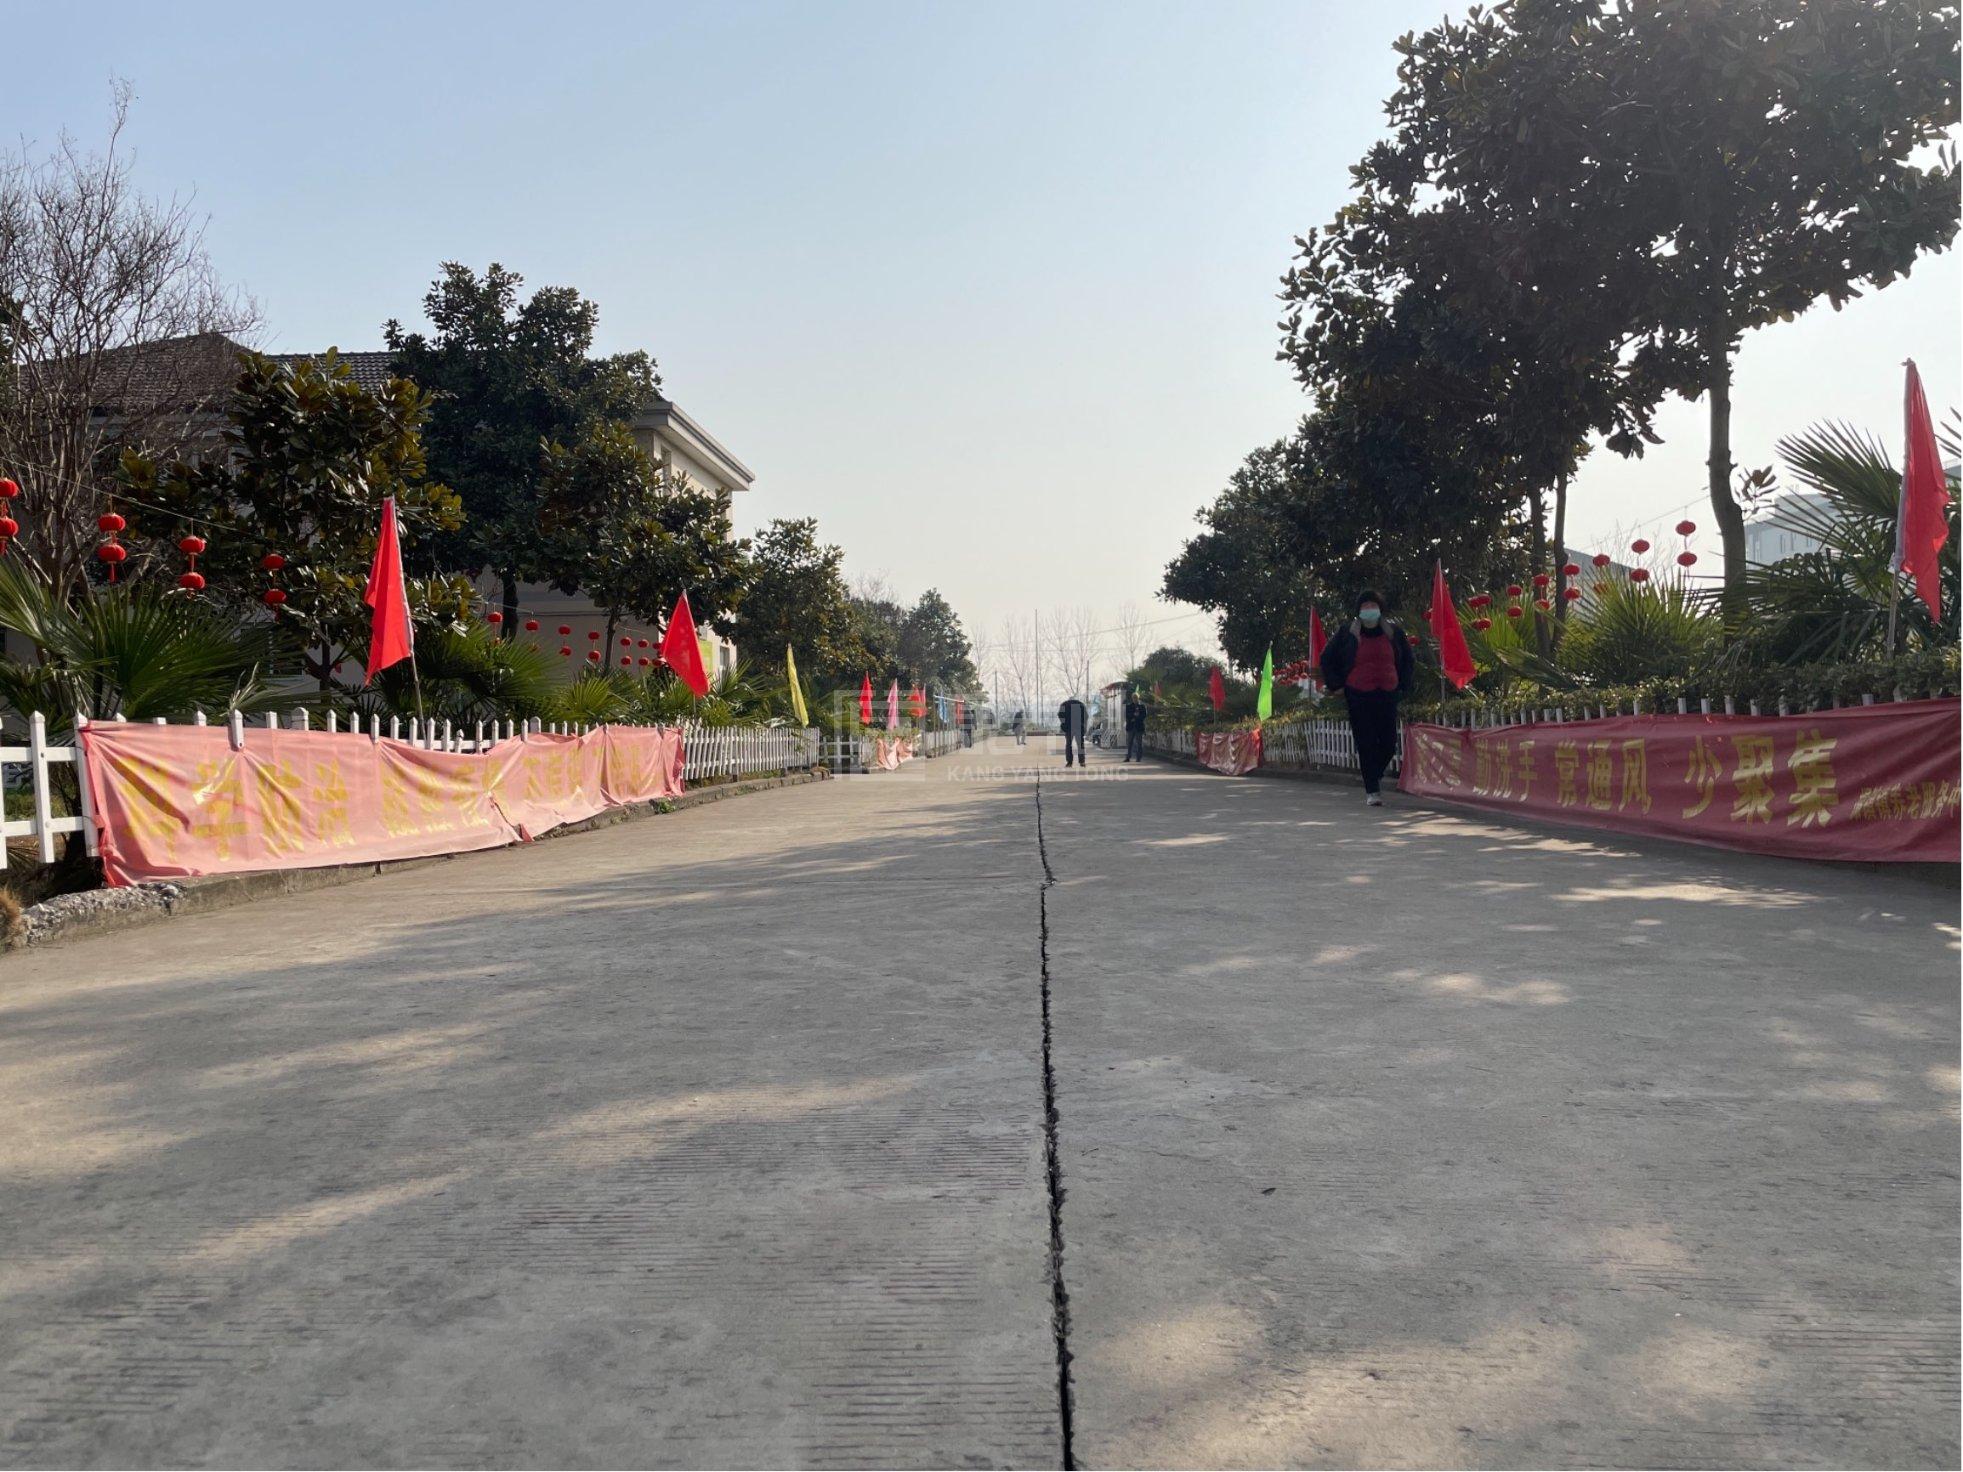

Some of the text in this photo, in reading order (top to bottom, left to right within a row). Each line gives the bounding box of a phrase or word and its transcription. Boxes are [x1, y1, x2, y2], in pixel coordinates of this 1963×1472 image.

[1472, 738, 1538, 802] 勤洗手
[1555, 737, 1652, 815] 常通风
[1682, 729, 1839, 831] 少聚集
